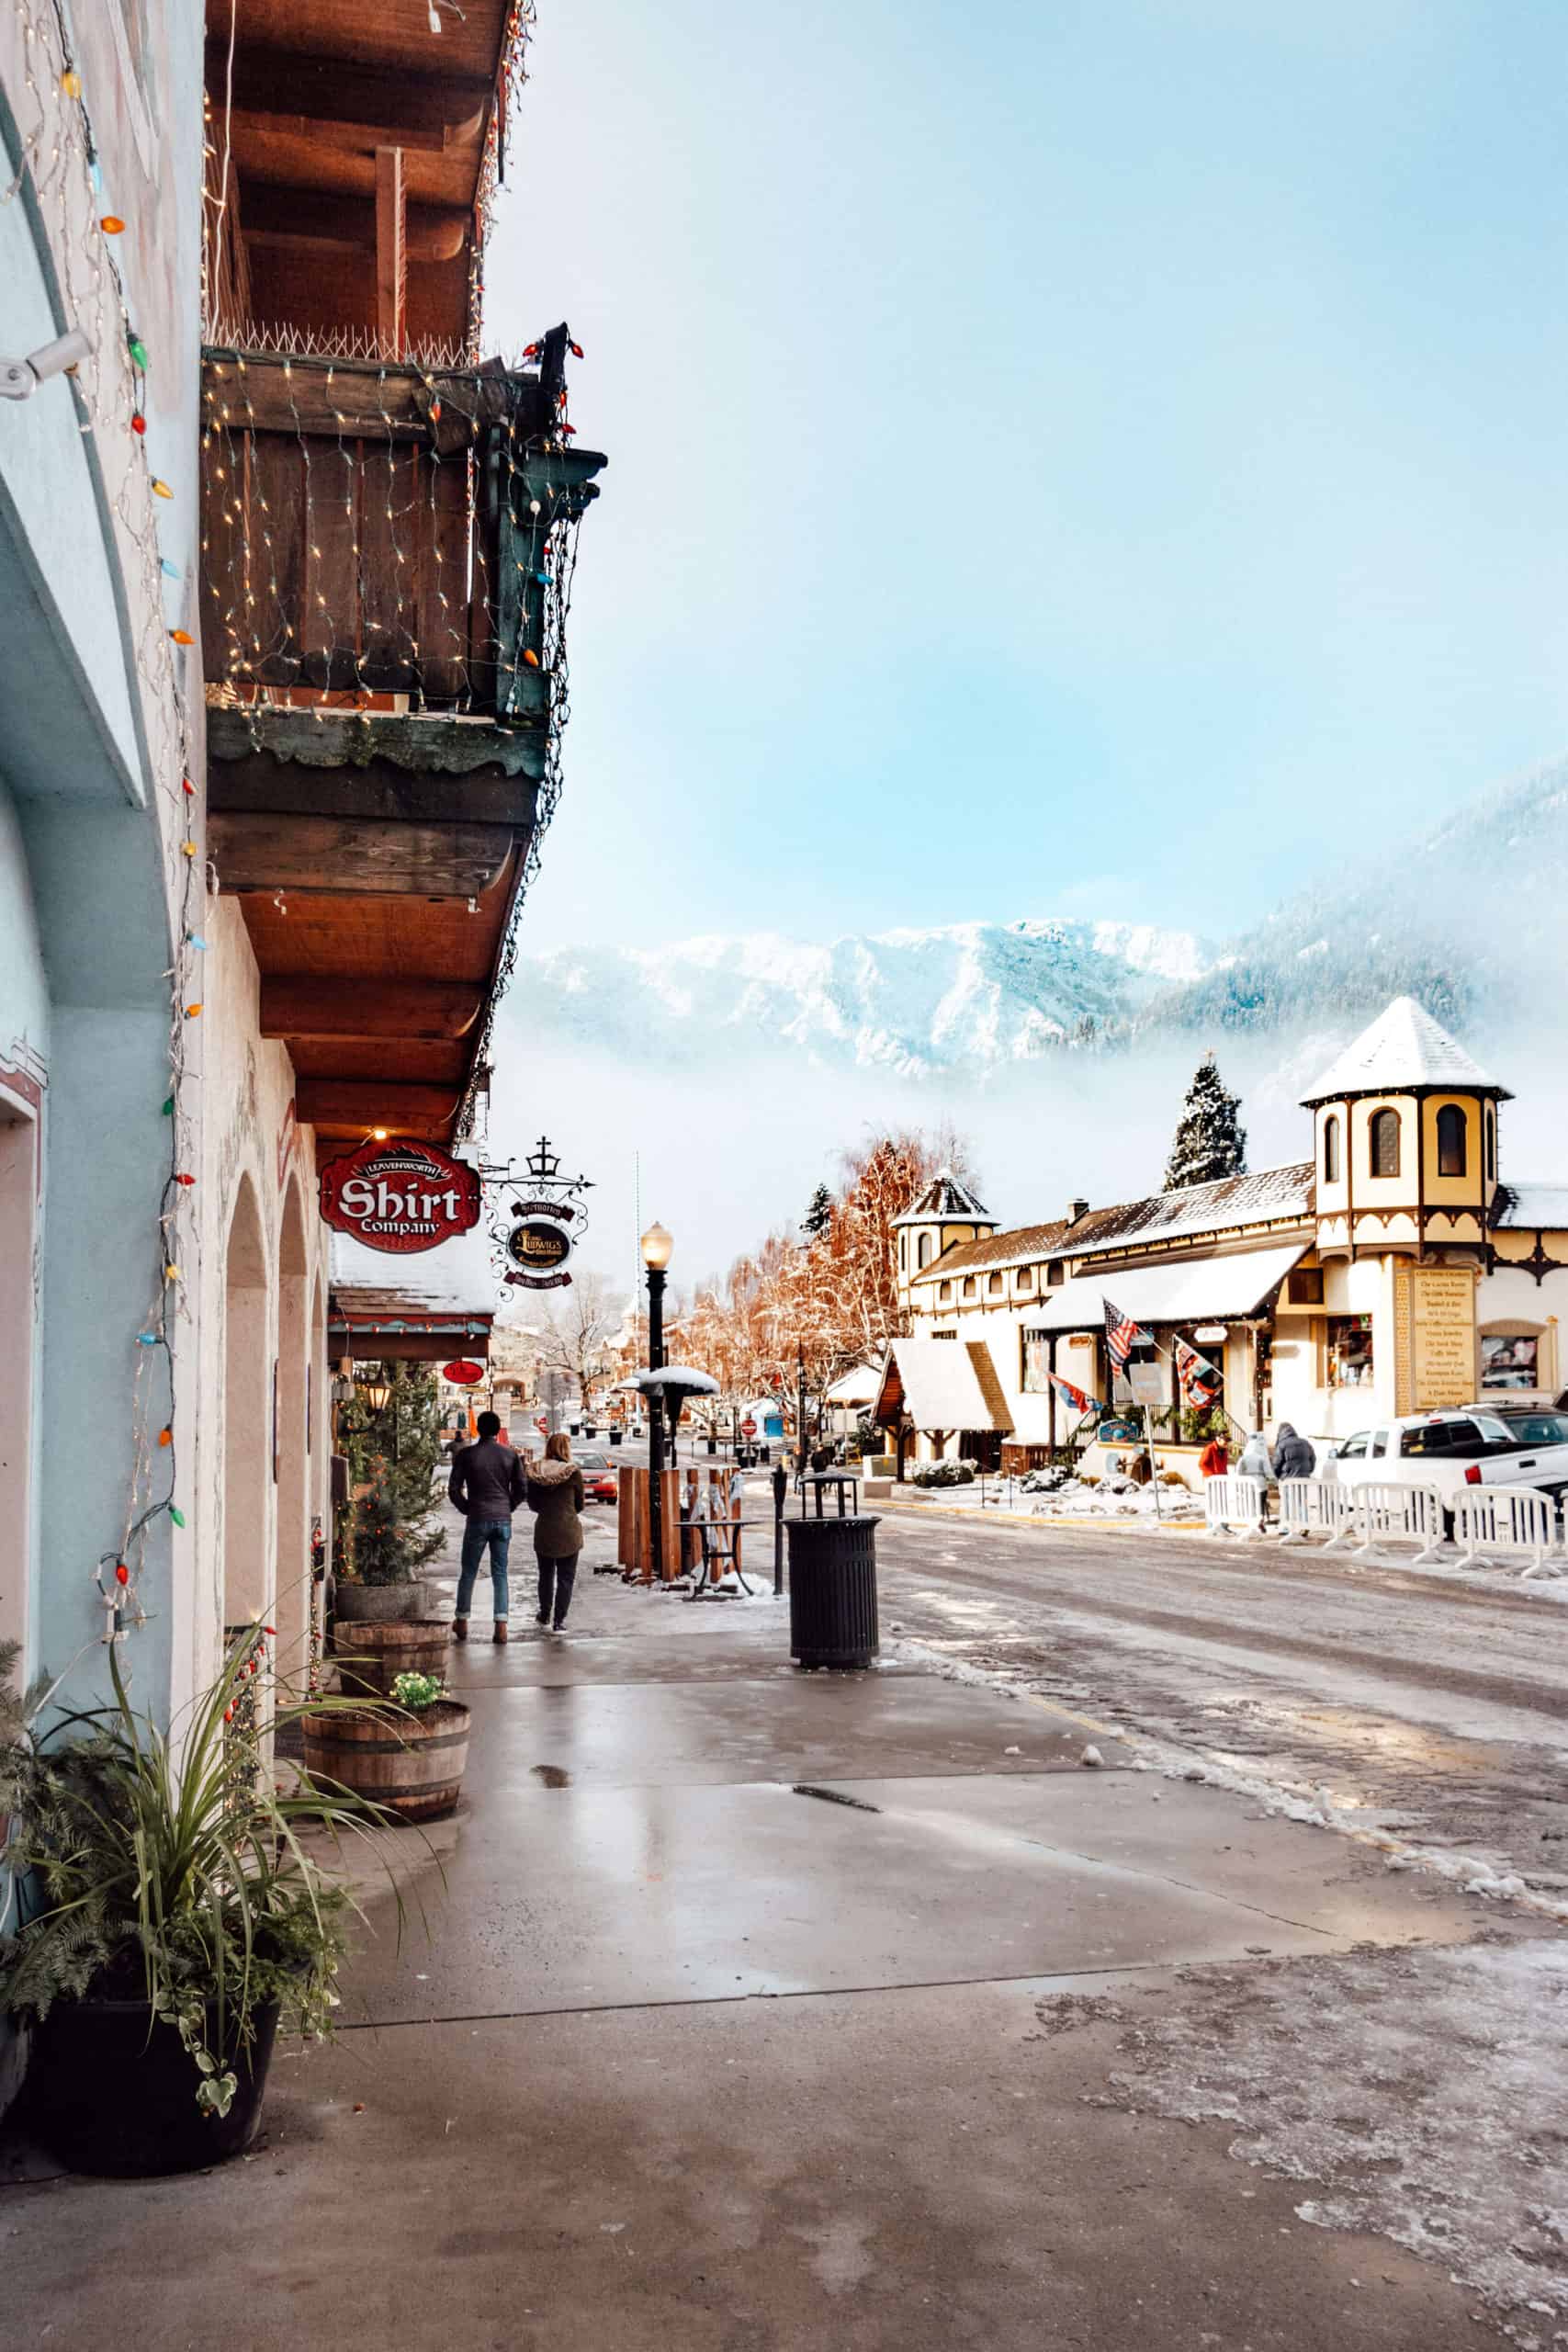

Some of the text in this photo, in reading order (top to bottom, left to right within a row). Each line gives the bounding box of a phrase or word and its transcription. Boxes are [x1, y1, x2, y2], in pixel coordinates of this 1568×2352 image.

[368, 1161, 436, 1175] LEAVENWORTH
[338, 1180, 461, 1220] Shirt
[361, 1218, 440, 1237] Company
